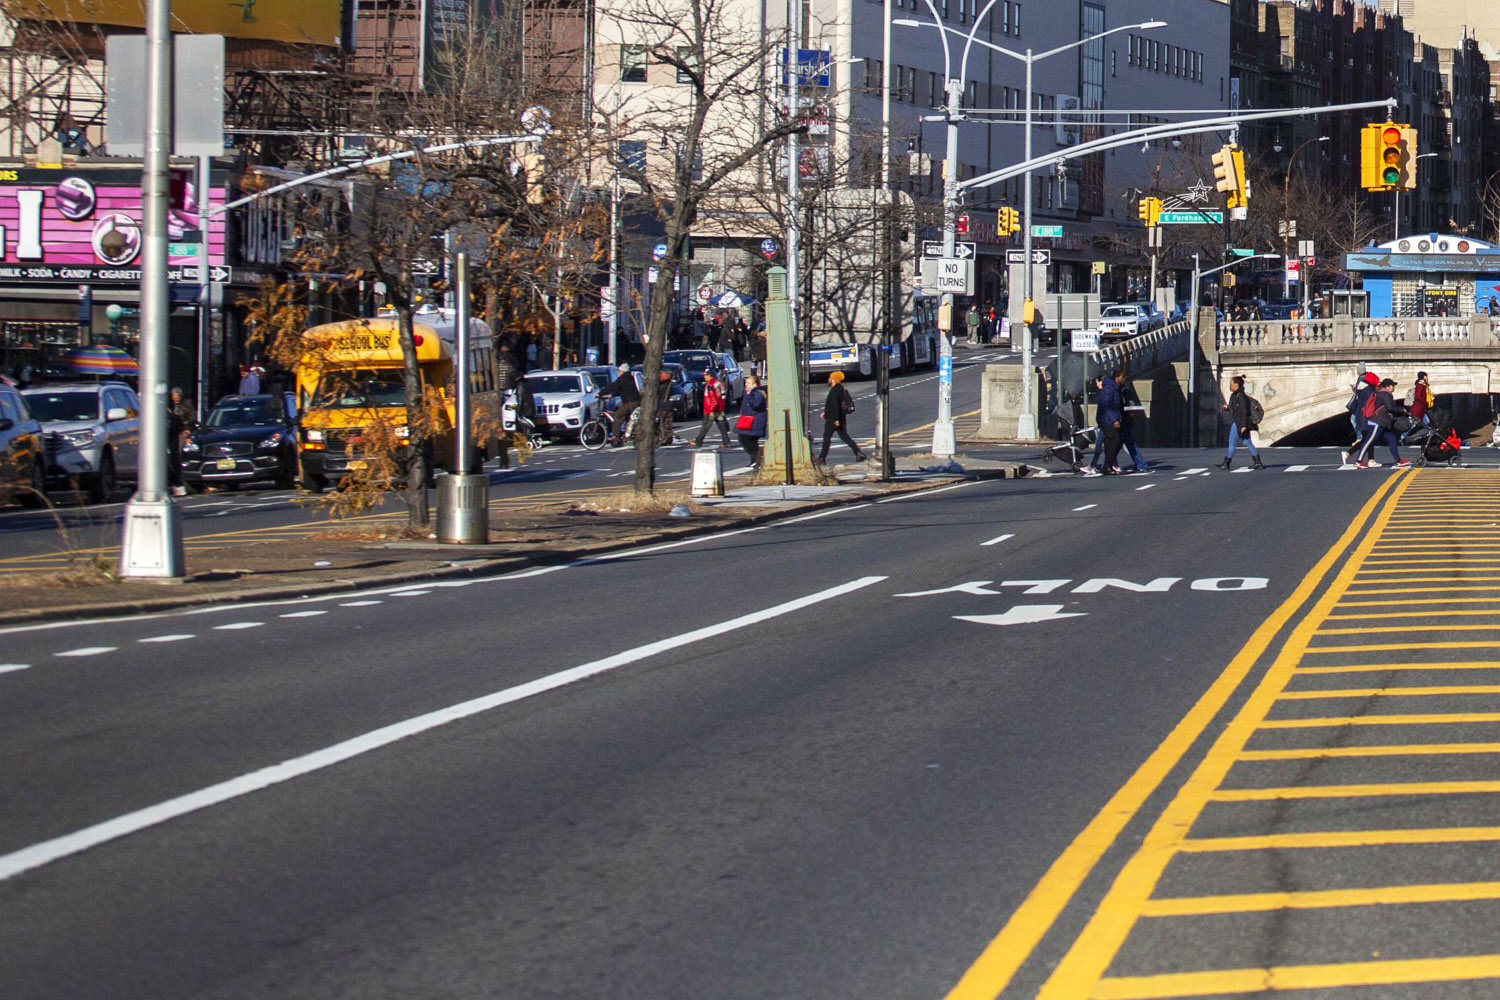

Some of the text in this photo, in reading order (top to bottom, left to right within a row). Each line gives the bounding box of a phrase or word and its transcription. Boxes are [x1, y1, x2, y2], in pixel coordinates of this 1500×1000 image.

[1036, 227, 1040, 236] E
[1042, 227, 1053, 236] 188
[28, 267, 53, 278] SODA
[60, 268, 92, 279] CANDY
[945, 264, 958, 274] NO
[938, 277, 964, 287] TURNS
[339, 335, 389, 349] SCHOOL BUS
[893, 577, 1270, 598] ONLY
